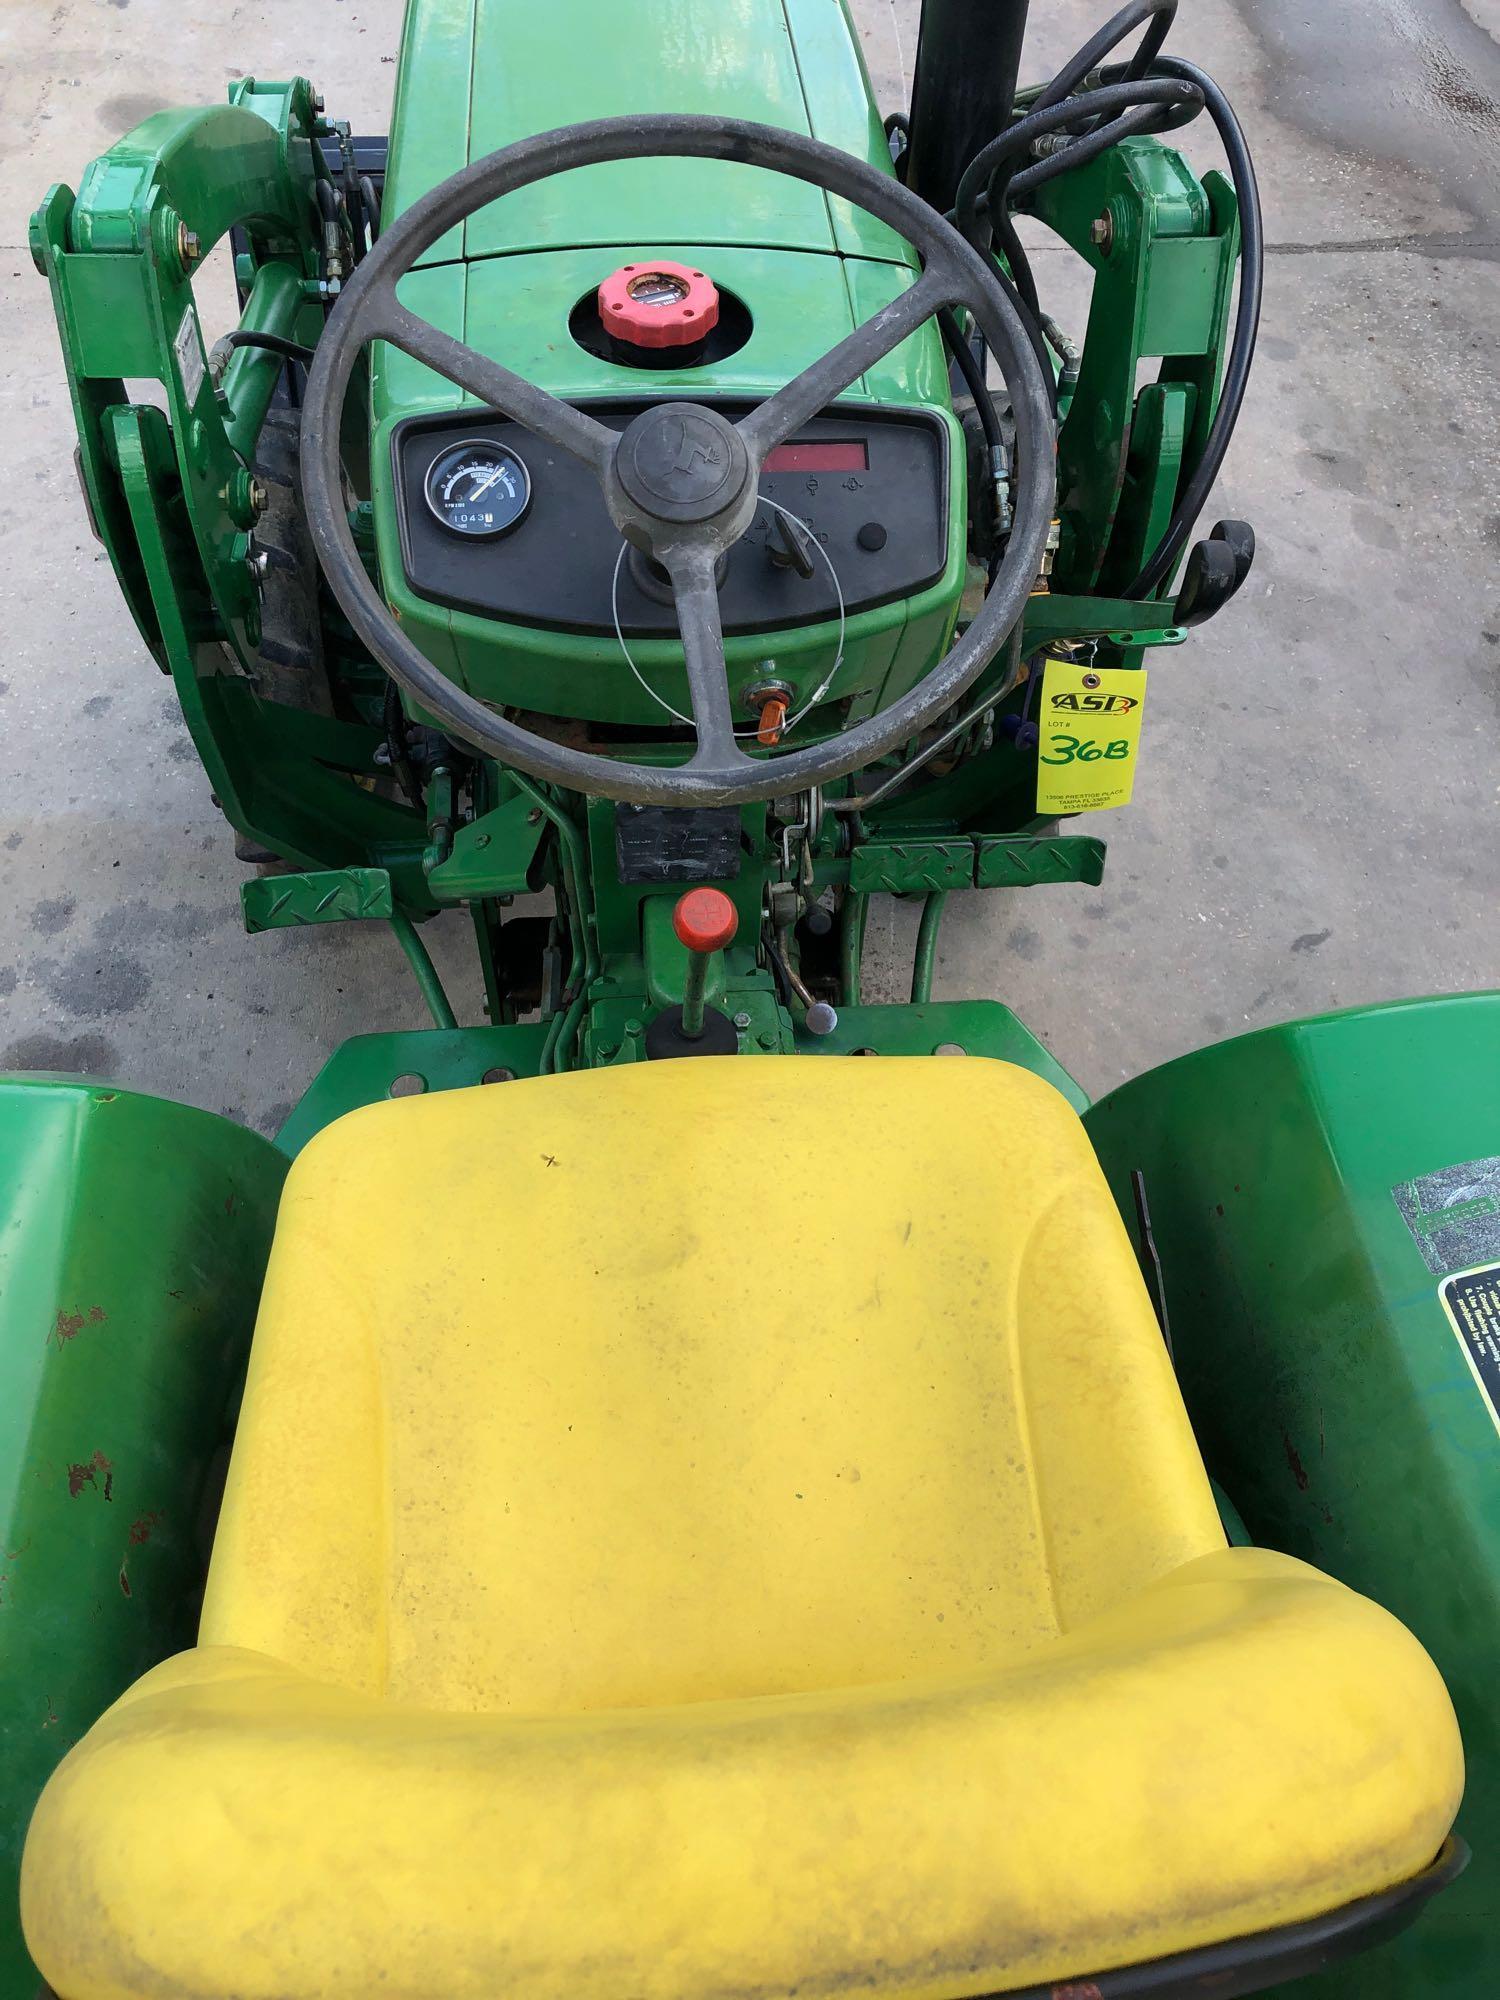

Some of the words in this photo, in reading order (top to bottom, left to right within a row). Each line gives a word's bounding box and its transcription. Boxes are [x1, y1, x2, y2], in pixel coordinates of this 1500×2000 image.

[1040, 735, 1129, 766] 36B
[1065, 792, 1101, 800] PRESTIGE
[1101, 789, 1124, 797] PLACE
[1457, 1299, 1478, 1332] prohibited
[1479, 1292, 1493, 1316] Couple
